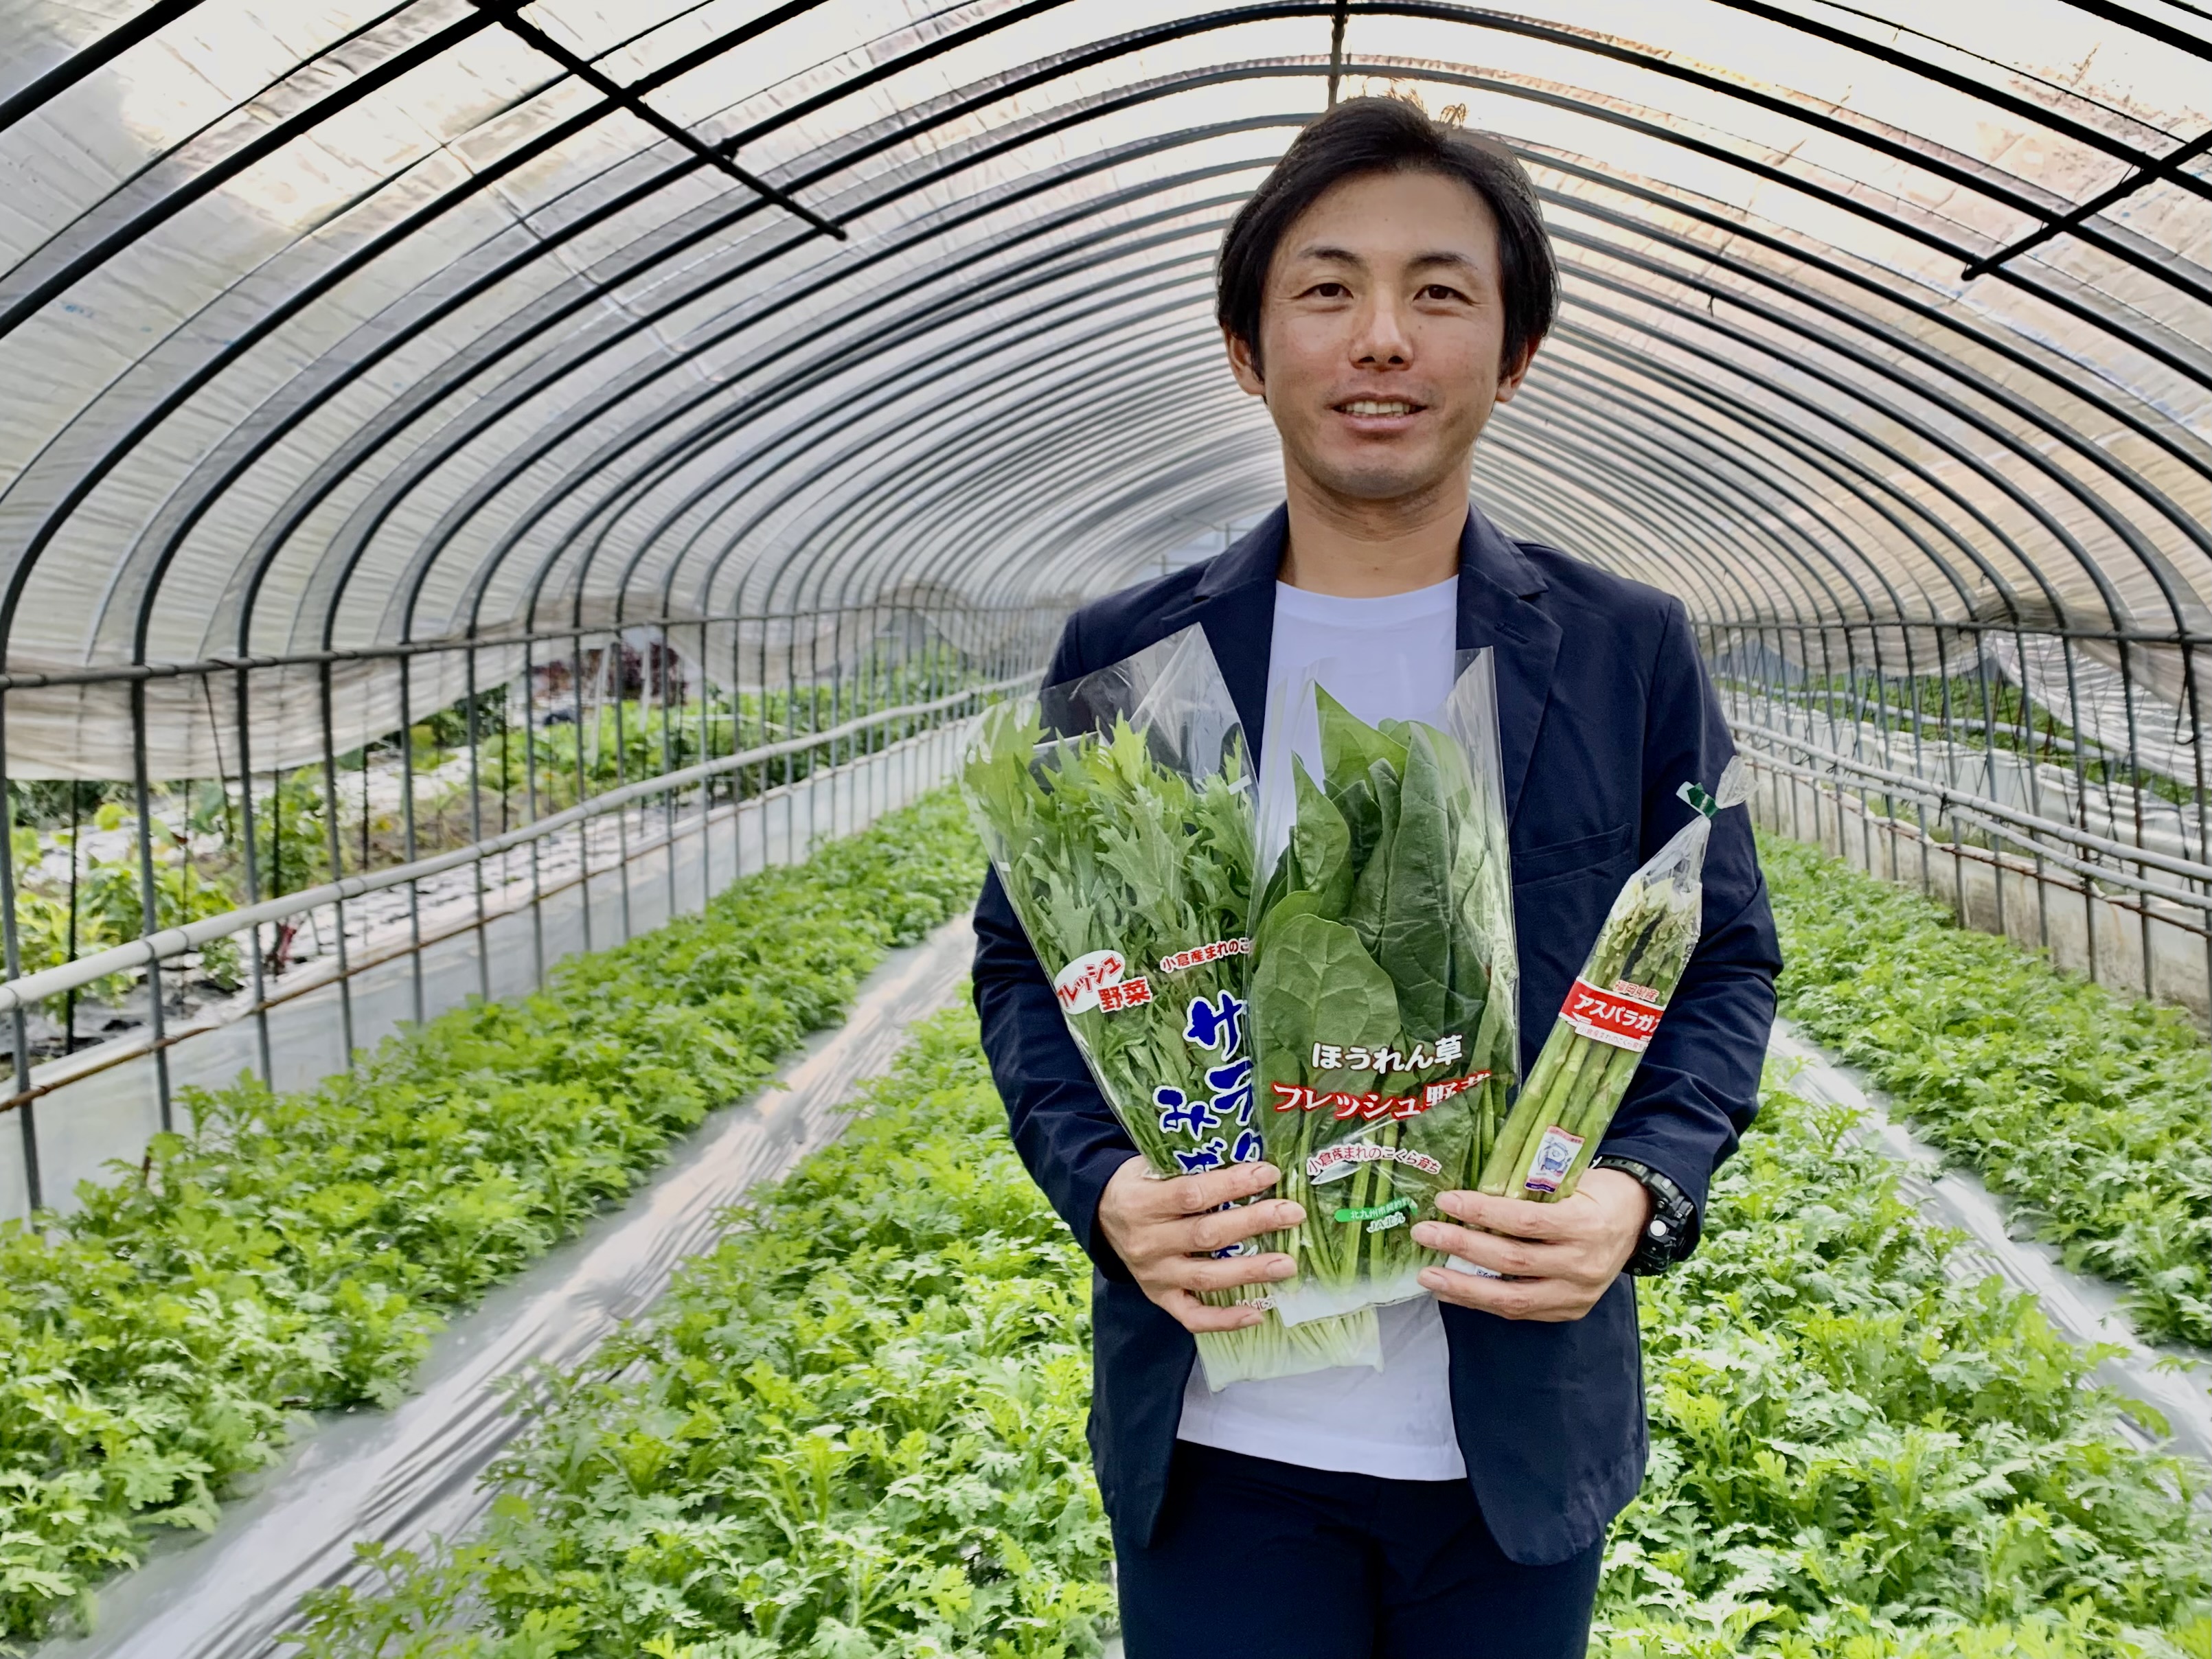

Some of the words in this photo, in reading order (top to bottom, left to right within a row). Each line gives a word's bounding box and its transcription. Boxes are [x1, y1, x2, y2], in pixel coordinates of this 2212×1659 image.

[1097, 978, 1150, 1011] 野菜
[1615, 981, 1659, 1001] 福岡県産
[1312, 1034, 1463, 1075] ほうれん草
[1308, 1145, 1441, 1174] 小倉産まれのこくら育ち
